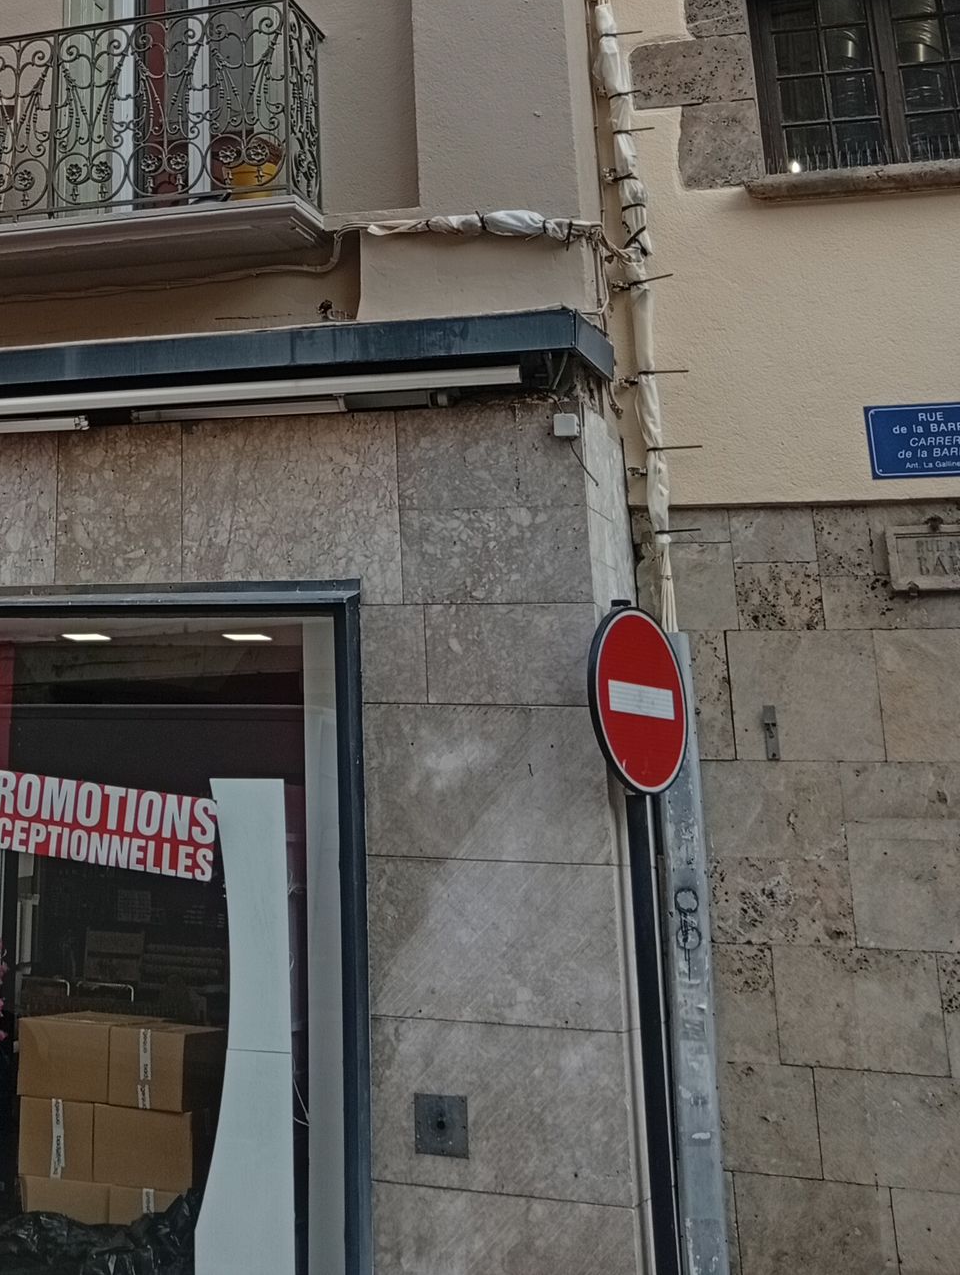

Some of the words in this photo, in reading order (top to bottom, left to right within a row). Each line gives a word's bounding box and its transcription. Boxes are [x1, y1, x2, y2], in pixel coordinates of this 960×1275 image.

[918, 412, 944, 421] RUE
[892, 424, 907, 434] de
[912, 424, 924, 433] la
[910, 436, 960, 447] CARRER
[897, 449, 912, 458] de
[917, 448, 928, 458] la
[933, 447, 960, 458] BAR
